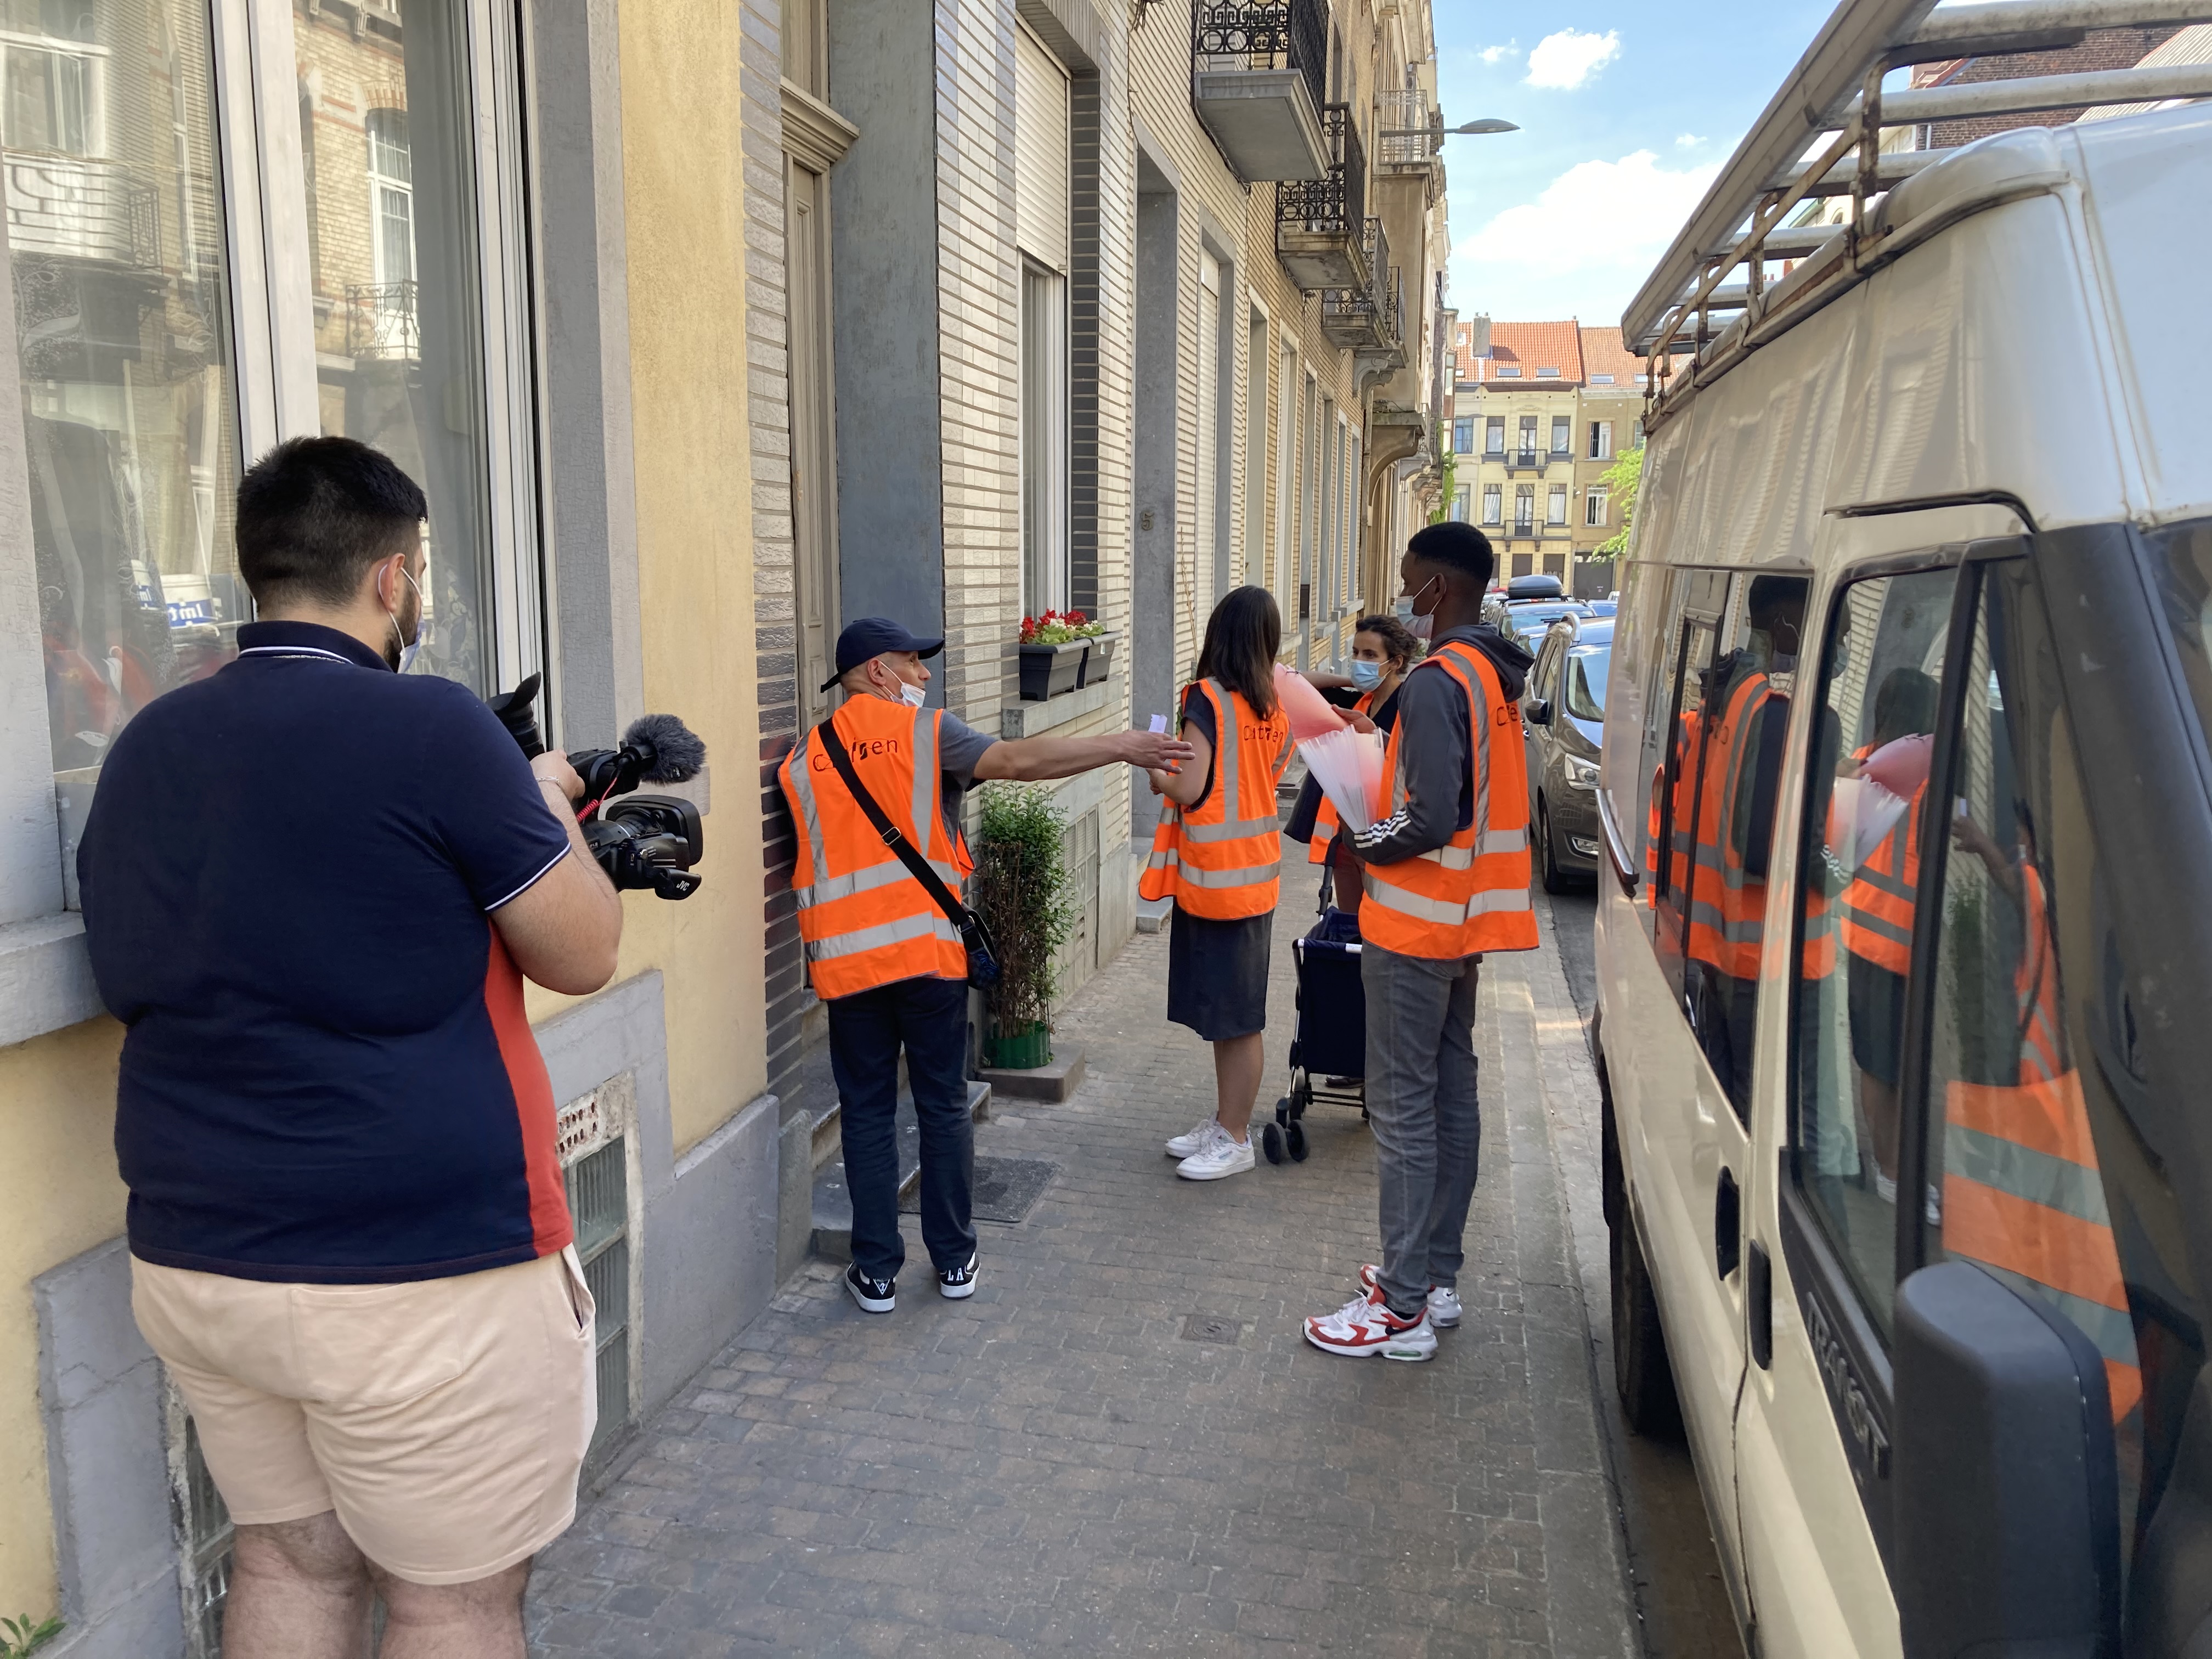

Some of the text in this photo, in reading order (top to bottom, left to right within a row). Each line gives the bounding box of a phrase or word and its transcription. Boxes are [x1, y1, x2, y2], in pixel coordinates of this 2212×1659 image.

[1141, 511, 1154, 531] 5
[1243, 724, 1284, 742] Citzen
[812, 737, 898, 772] Cizen
[676, 880, 690, 891] JVC
[947, 1267, 964, 1281] LA
